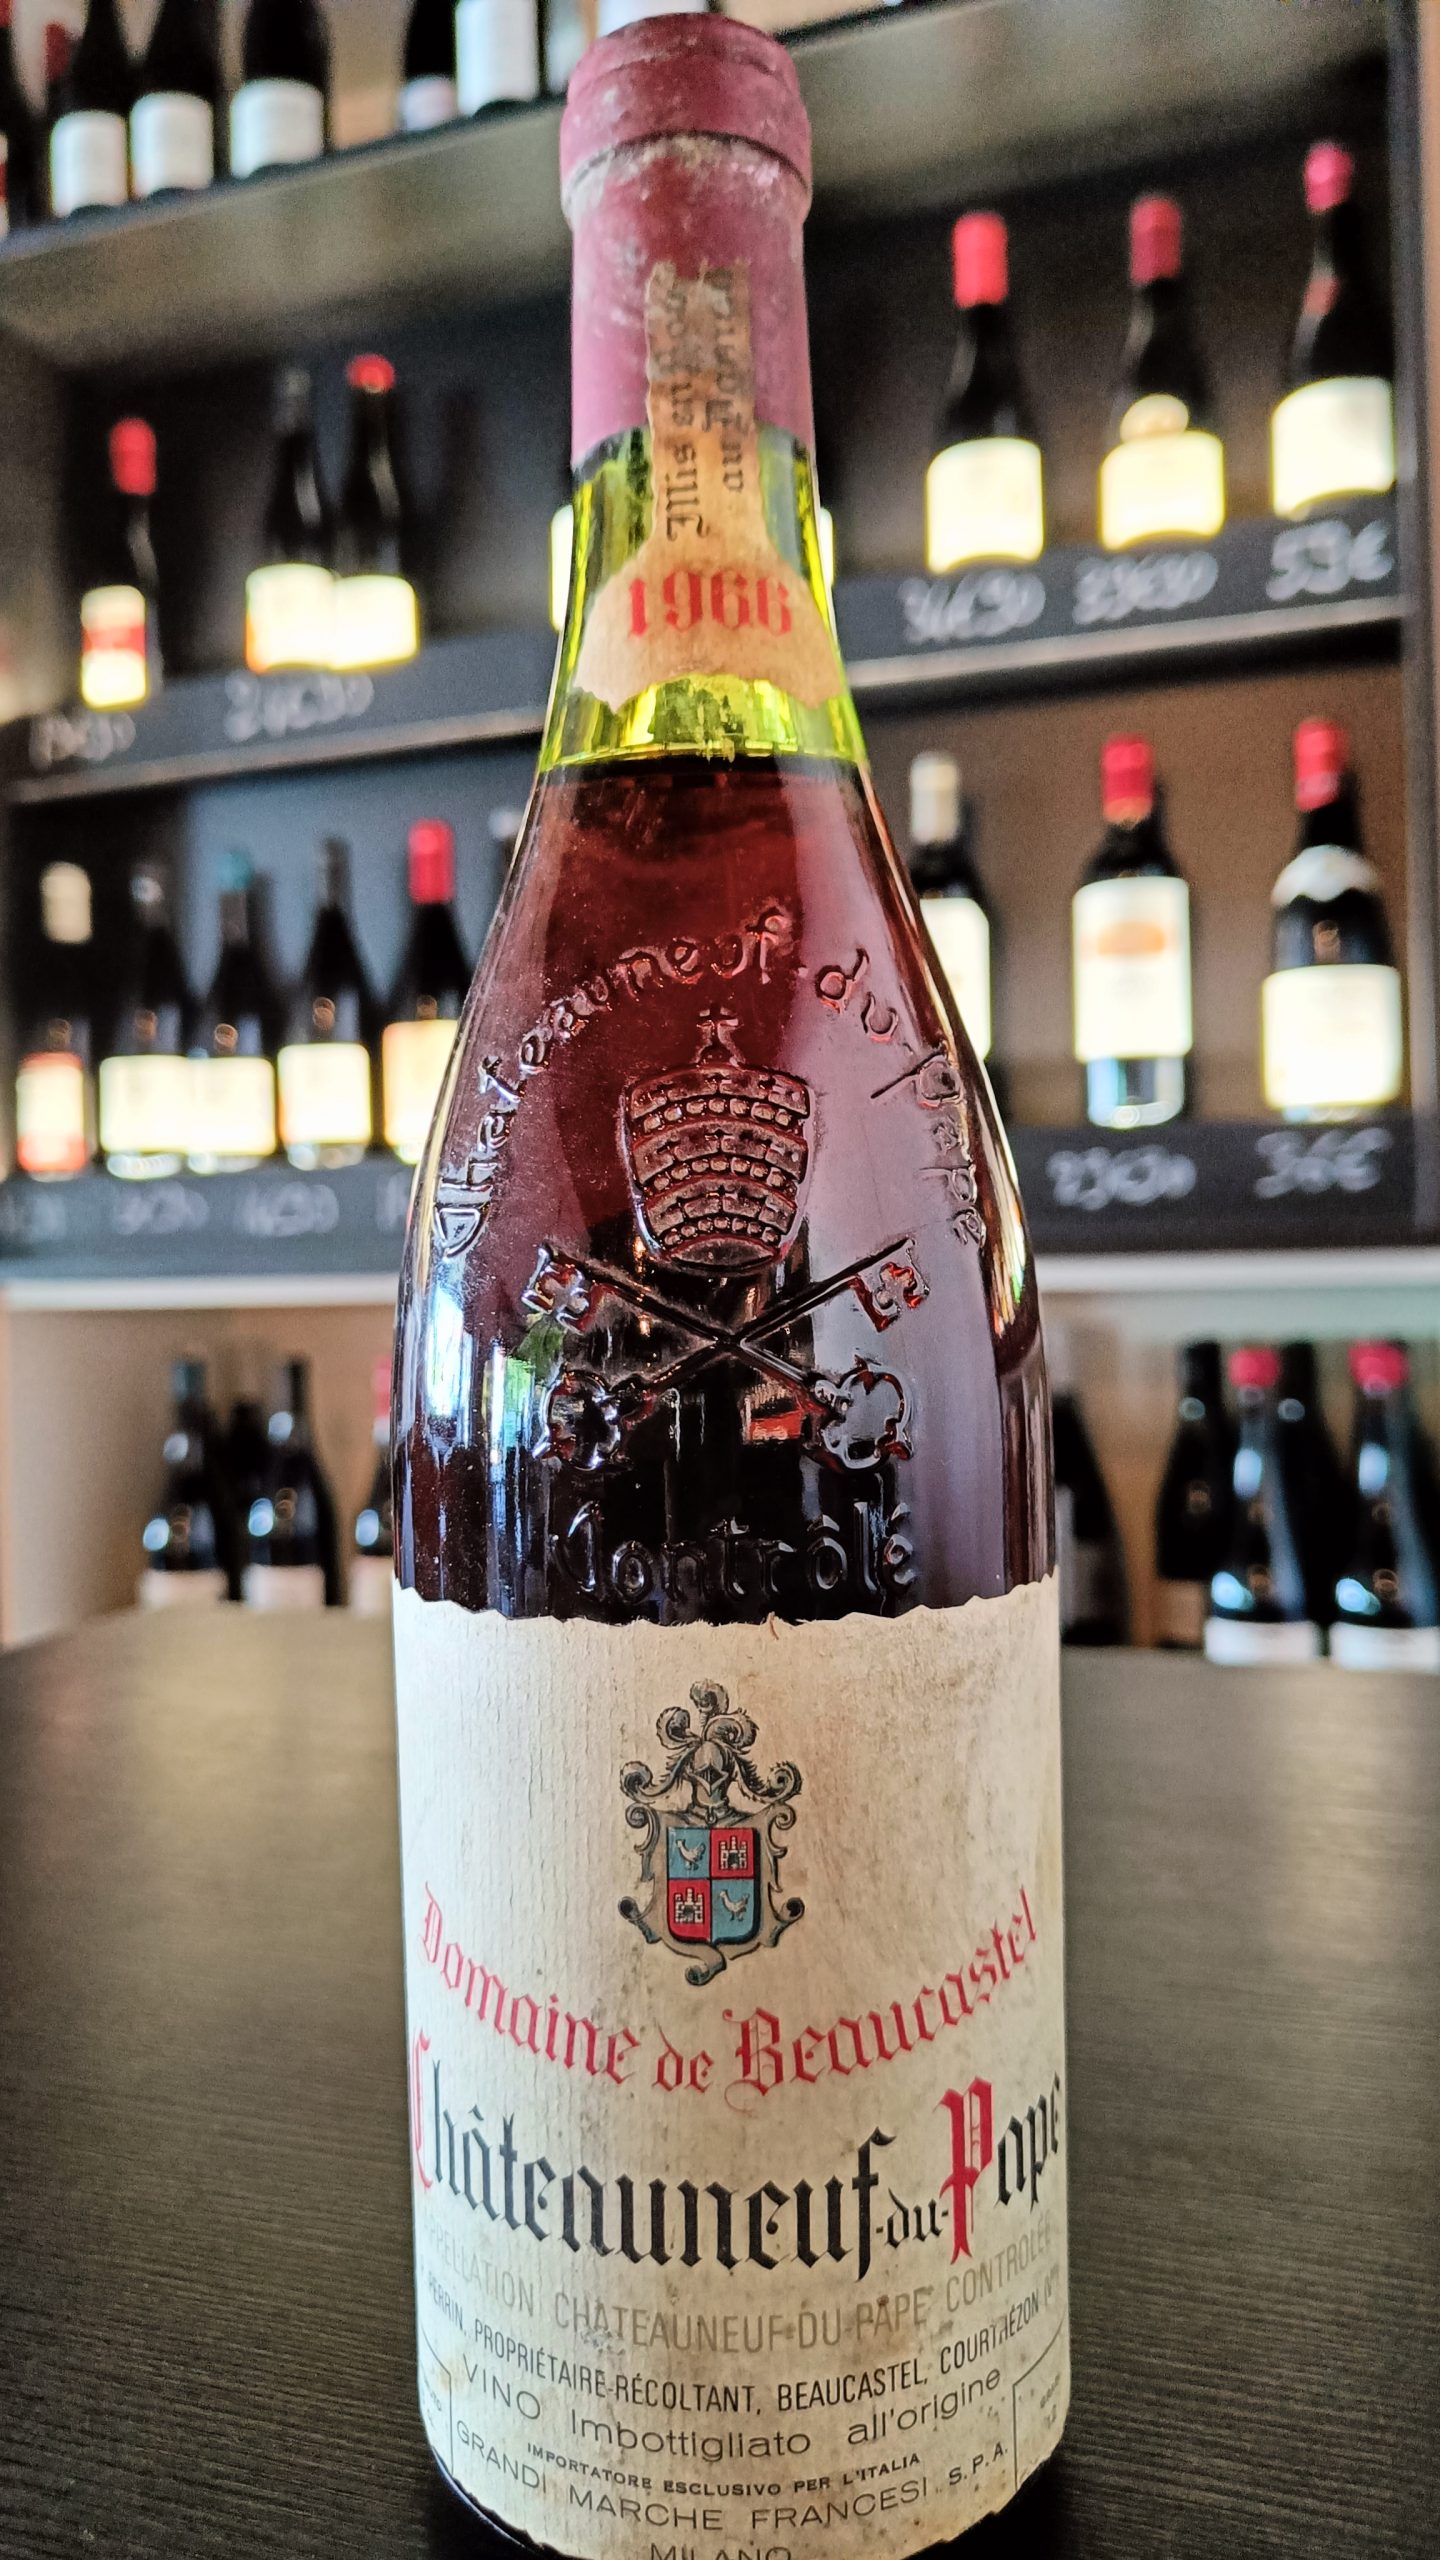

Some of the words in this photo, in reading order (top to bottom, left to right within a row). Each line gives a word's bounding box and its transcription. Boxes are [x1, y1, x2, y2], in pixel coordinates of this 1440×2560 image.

[628, 567, 793, 639] 1966
[419, 1880, 642, 2085] Domaine
[652, 2023, 716, 2093] de
[722, 1884, 1037, 2119] Beaucastel
[462, 2353, 541, 2420] VINO
[571, 2408, 811, 2463] Imbottigliato
[847, 2369, 1001, 2446] all'origine
[777, 2357, 928, 2412] BEAUCASTEL,
[456, 2419, 548, 2494] GRANDI
[569, 2483, 724, 2532] MARCHE
[751, 2476, 928, 2530] FRANCESI
[527, 2442, 653, 2490] IMPORTATORE
[663, 2479, 782, 2497] ESCLUSIVO
[793, 2476, 831, 2494] PER
[842, 2452, 921, 2487] L'ITALIA
